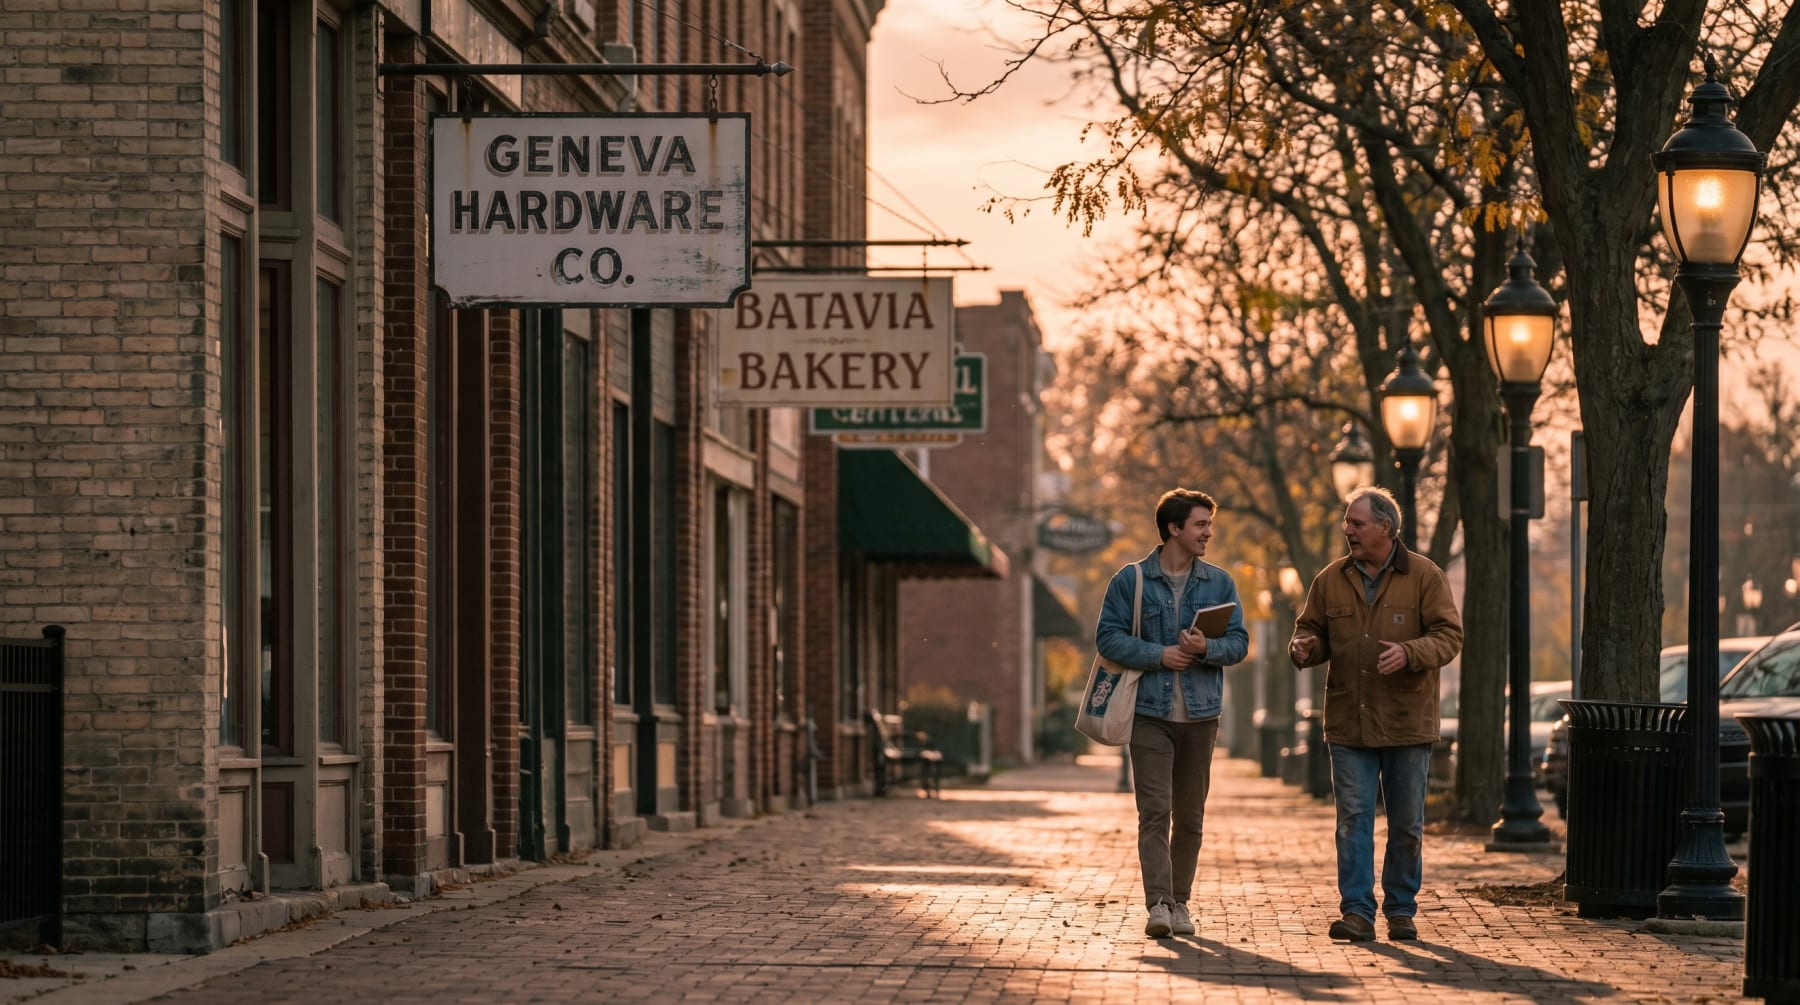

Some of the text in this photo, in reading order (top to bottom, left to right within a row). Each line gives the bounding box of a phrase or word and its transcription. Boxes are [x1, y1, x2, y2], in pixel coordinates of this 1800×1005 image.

[485, 134, 697, 176] GENEVA
[450, 190, 725, 235] HARDWARE
[551, 247, 635, 286] CO.
[735, 292, 935, 330] BATAVIA
[738, 352, 930, 390] BAKERY
